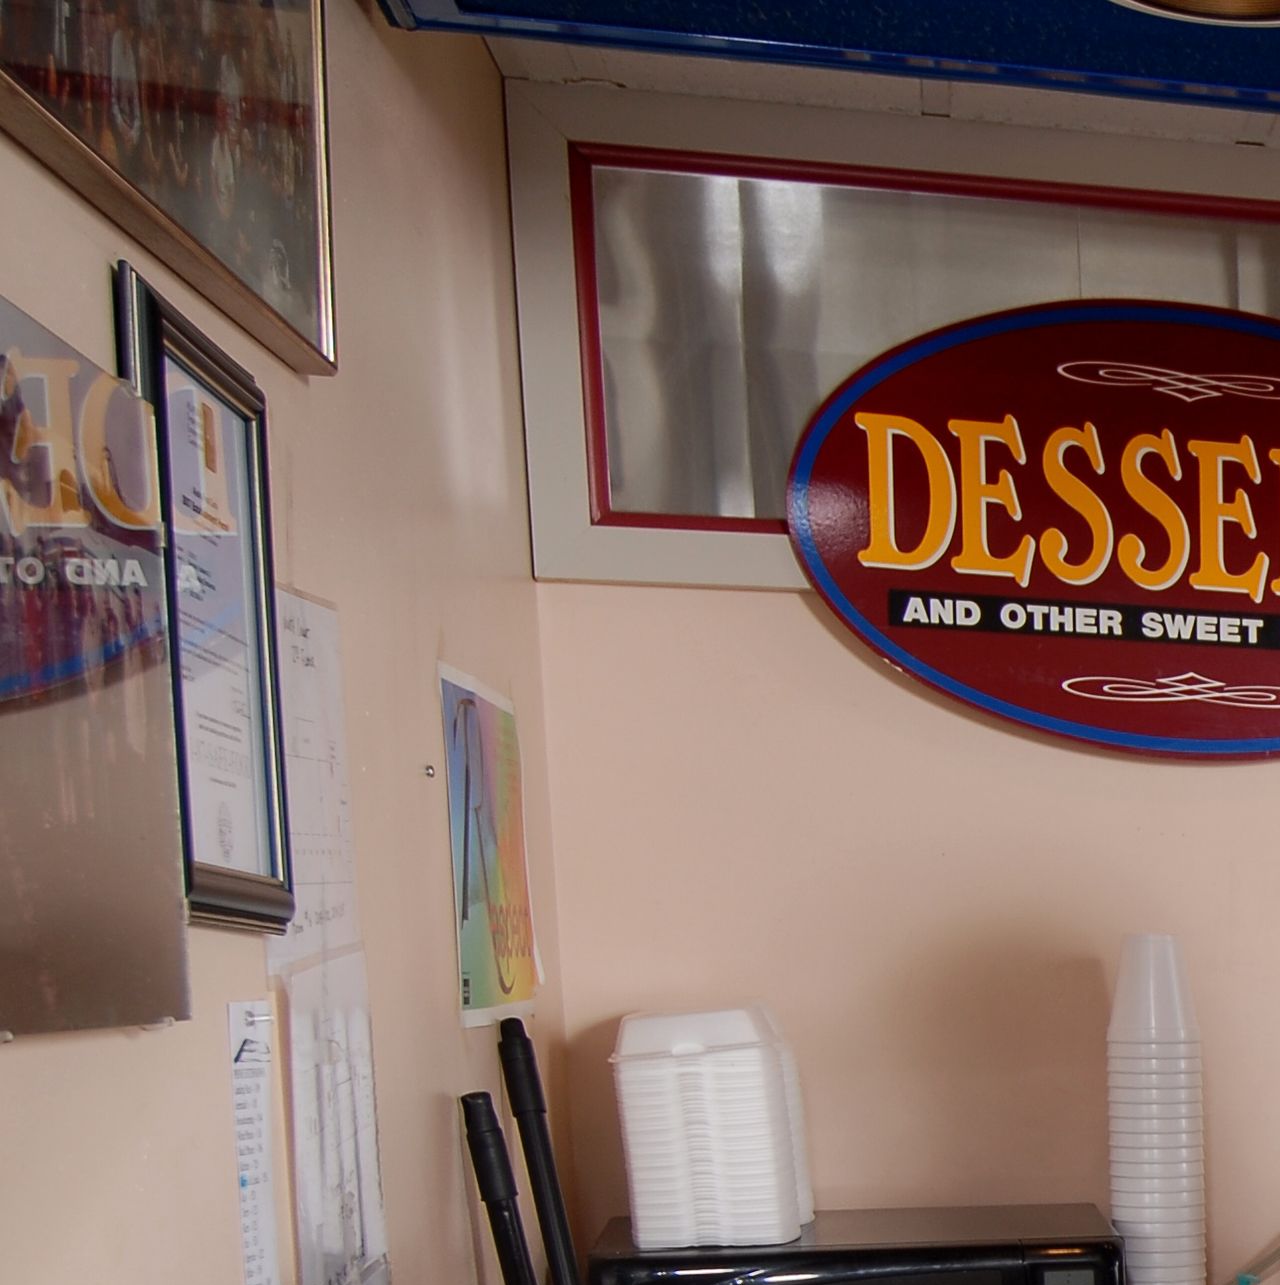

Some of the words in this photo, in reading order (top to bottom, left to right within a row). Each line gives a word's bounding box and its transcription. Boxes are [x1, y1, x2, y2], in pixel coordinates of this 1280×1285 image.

[902, 596, 982, 629] AND
[1000, 602, 1124, 637] OTHER
[1141, 611, 1264, 647] SWEET
